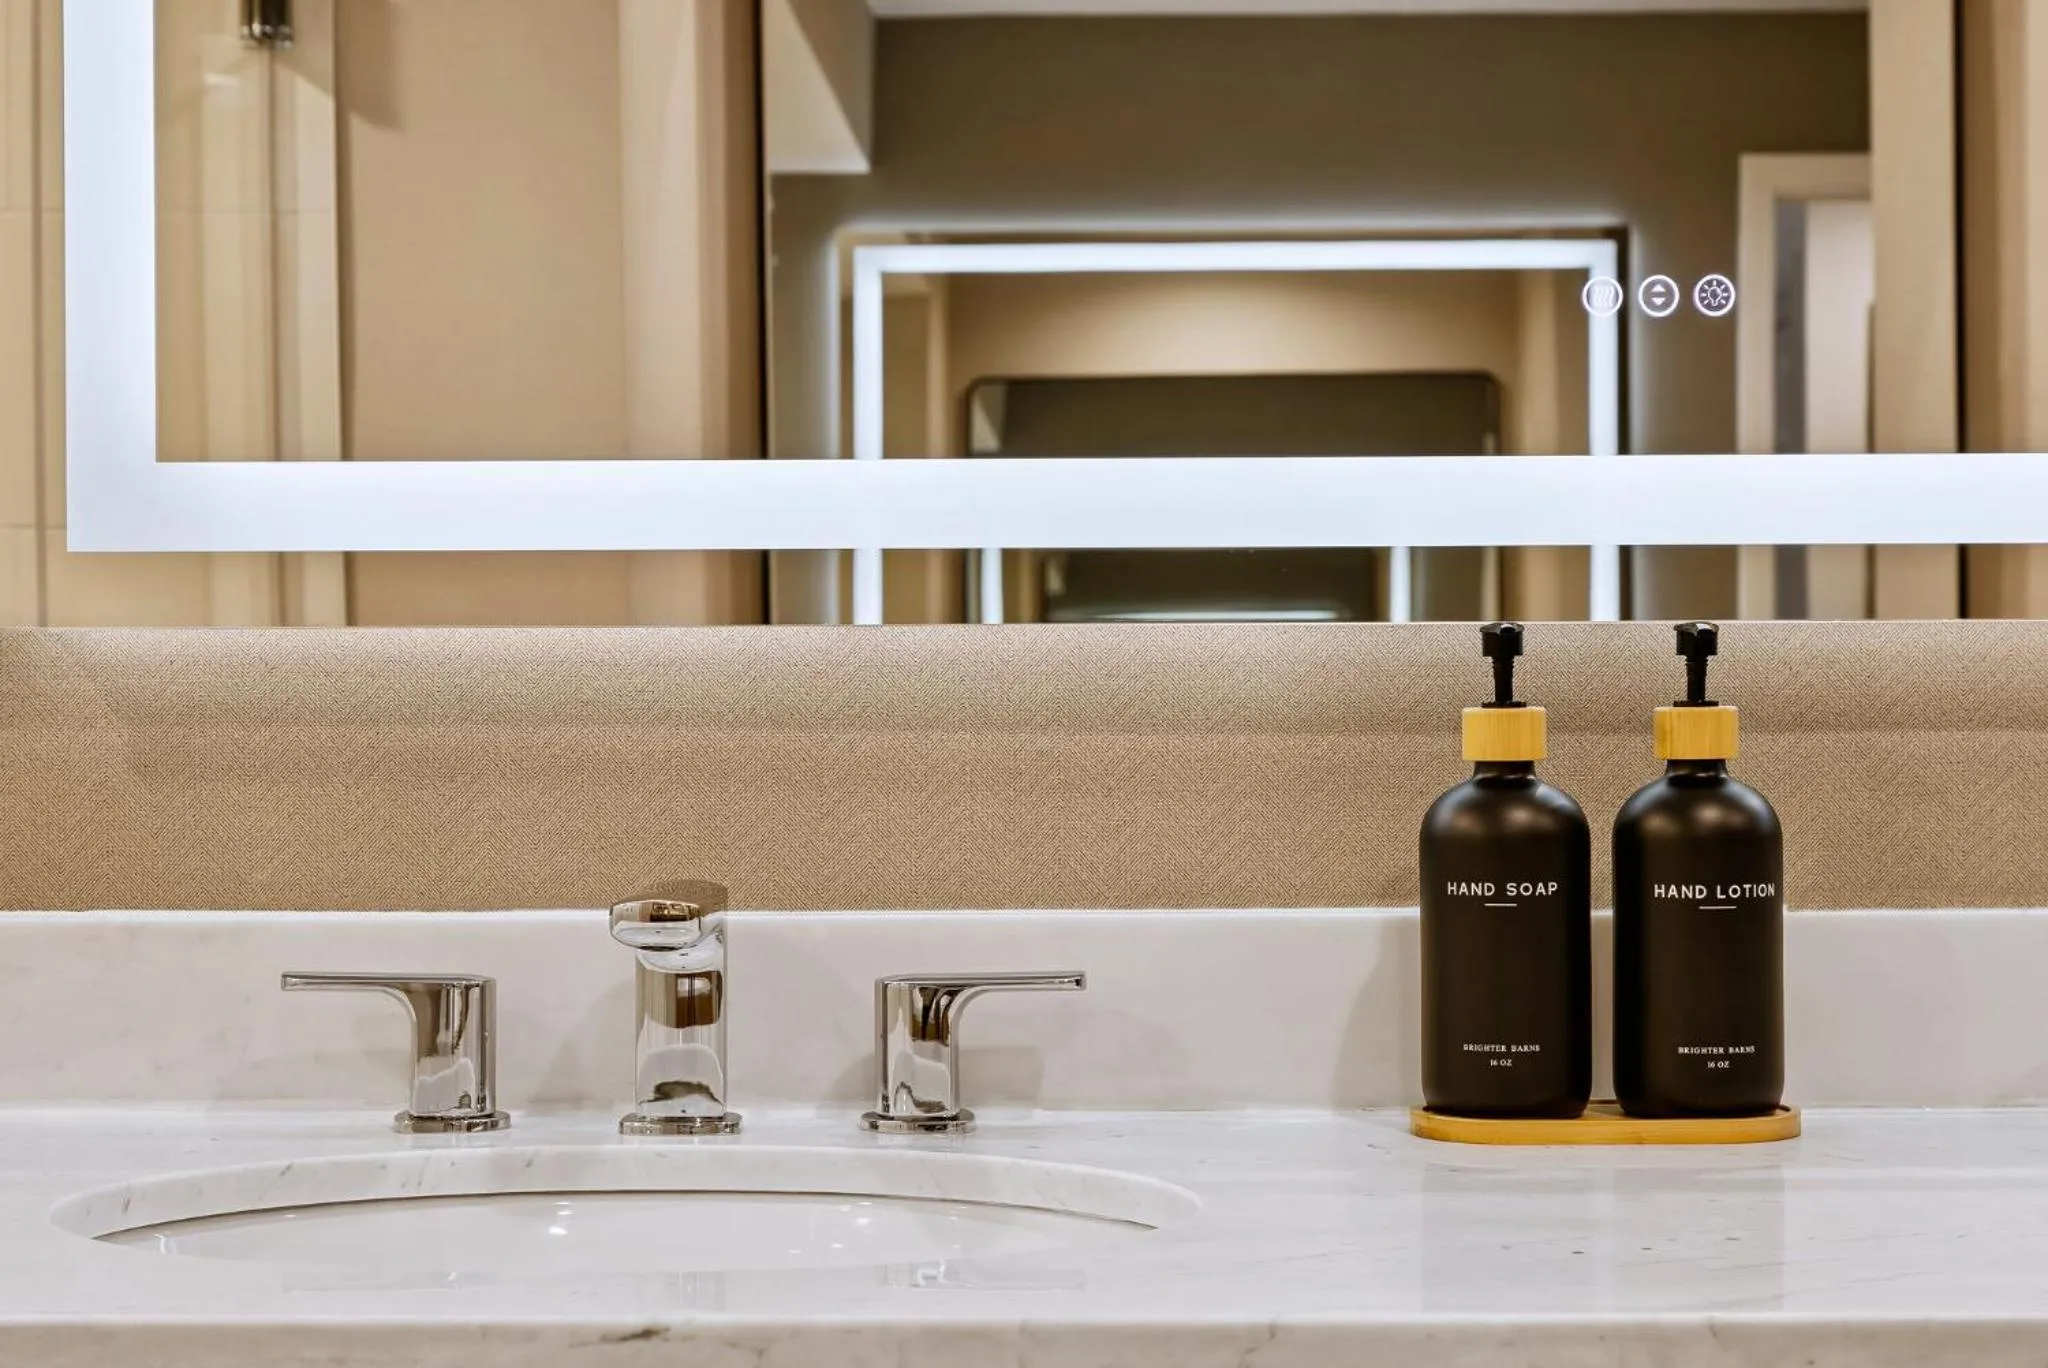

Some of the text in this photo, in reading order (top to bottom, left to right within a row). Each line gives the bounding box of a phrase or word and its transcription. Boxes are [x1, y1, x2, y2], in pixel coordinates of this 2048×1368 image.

[1447, 880, 1559, 897] HAND SOAP
[1653, 882, 1776, 900] HAND LOTION
[1462, 1043, 1541, 1053] BRIGHTER BARNS
[1677, 1045, 1756, 1055] BRIGHTER BARNS
[1490, 1058, 1513, 1067] 16 OZ
[1707, 1060, 1730, 1069] 16 OZ
